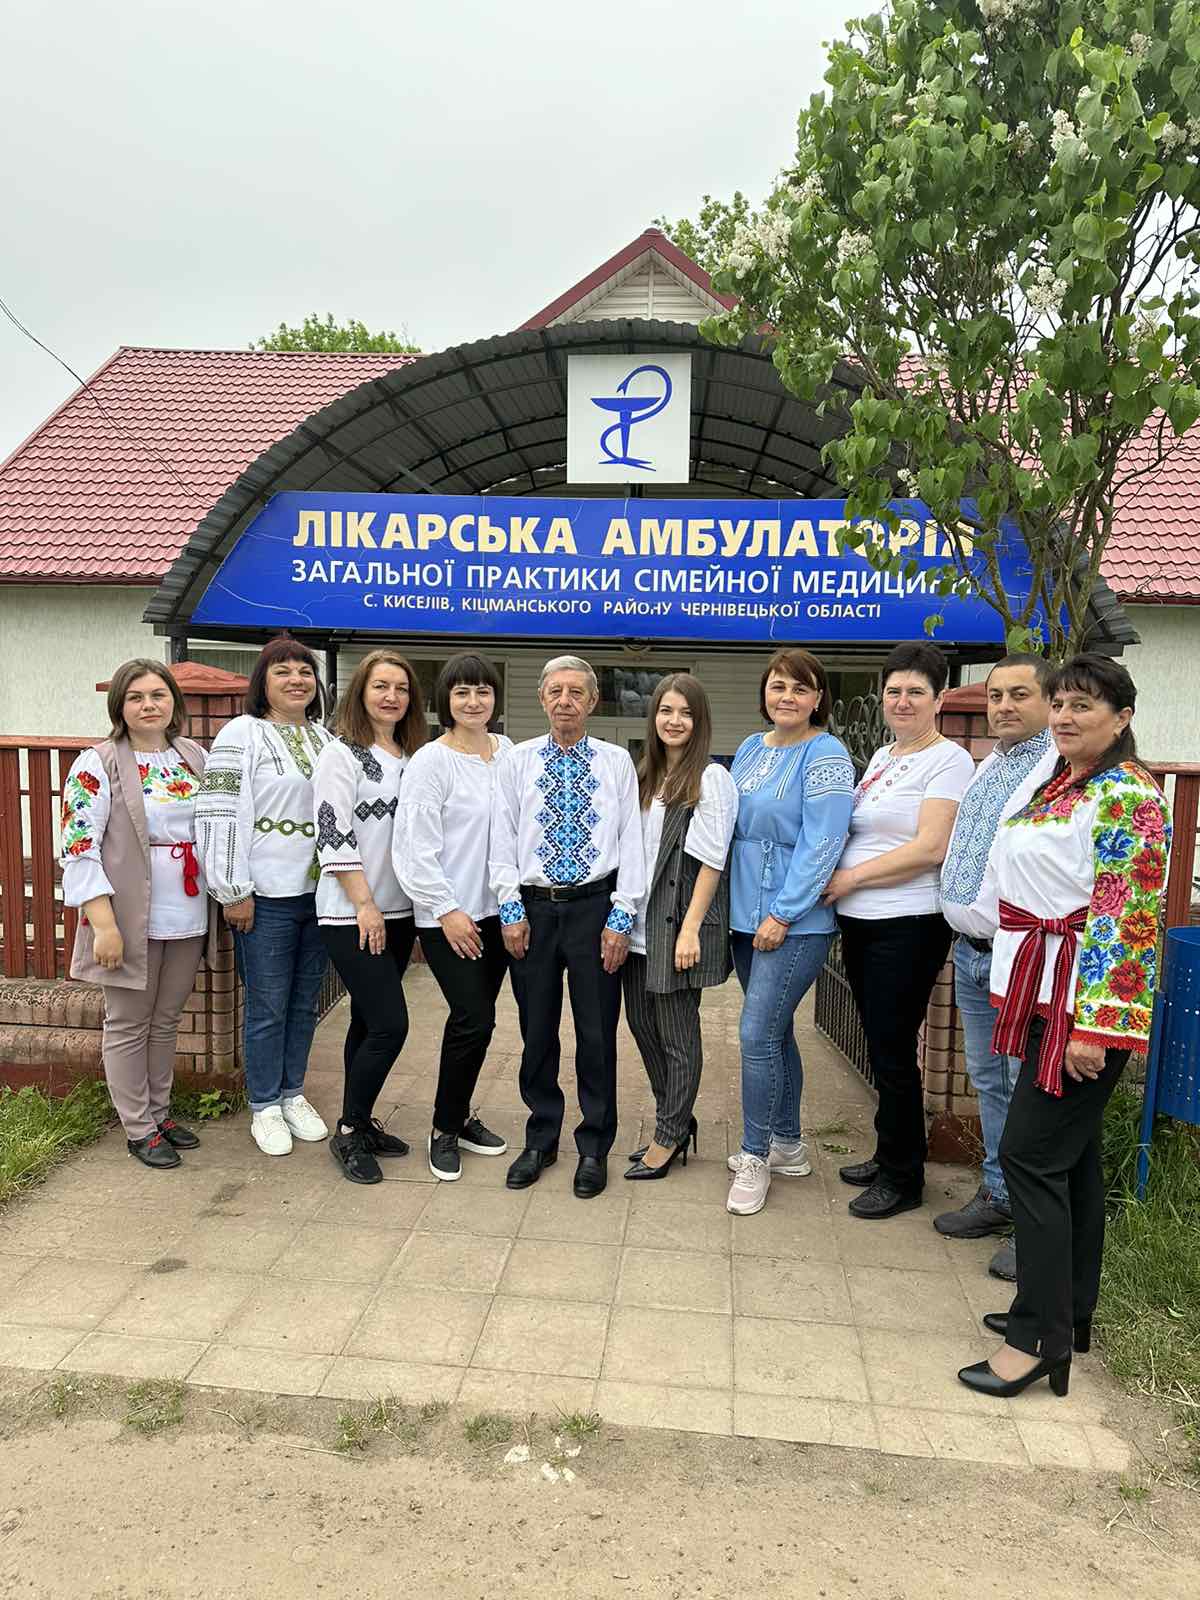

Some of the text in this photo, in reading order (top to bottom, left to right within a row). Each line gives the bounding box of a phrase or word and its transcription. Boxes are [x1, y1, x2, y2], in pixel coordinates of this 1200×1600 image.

[293, 510, 576, 554] ЛІКАРСЬКА
[291, 559, 454, 587] ЗАГАЛЬНОЇ
[467, 565, 620, 592] ПРАКТИКИ
[634, 564, 781, 595] СІМЕЙНОЇ
[363, 593, 881, 619] С. КИСЕЛІВ, КІЦМАНСЬКОГО РАЙОНУ ЧЕРНІВЕЦЬКОЇ ОБЛАСТІ
